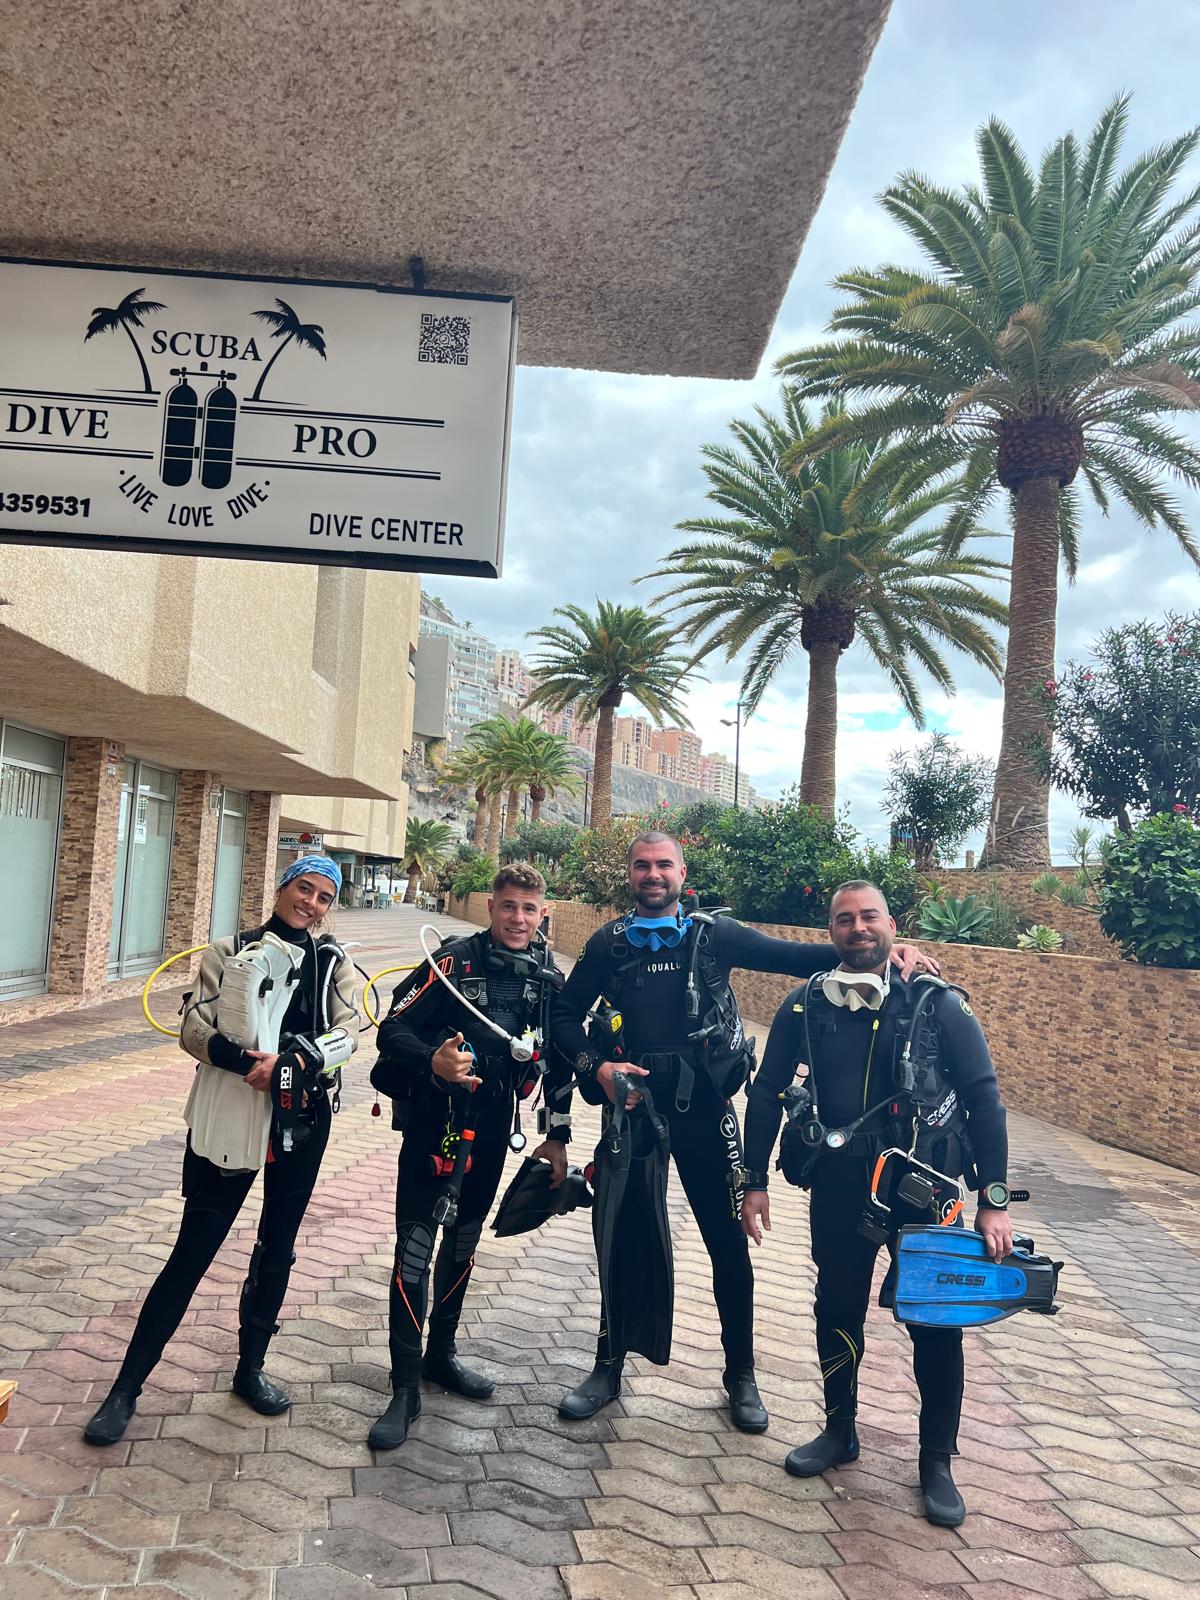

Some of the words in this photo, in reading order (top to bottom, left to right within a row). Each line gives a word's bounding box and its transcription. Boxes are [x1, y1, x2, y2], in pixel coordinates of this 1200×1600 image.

[151, 329, 264, 362] SCUBA
[5, 403, 110, 441] DIVE
[292, 423, 378, 459] PRO
[118, 474, 159, 514] LIVE
[167, 503, 214, 528] LOVE
[226, 482, 269, 520] DIVE
[309, 512, 363, 539] DIVE
[371, 517, 464, 546] CENTER
[280, 1066, 290, 1090] PRO
[936, 1272, 986, 1287] CRESSI
